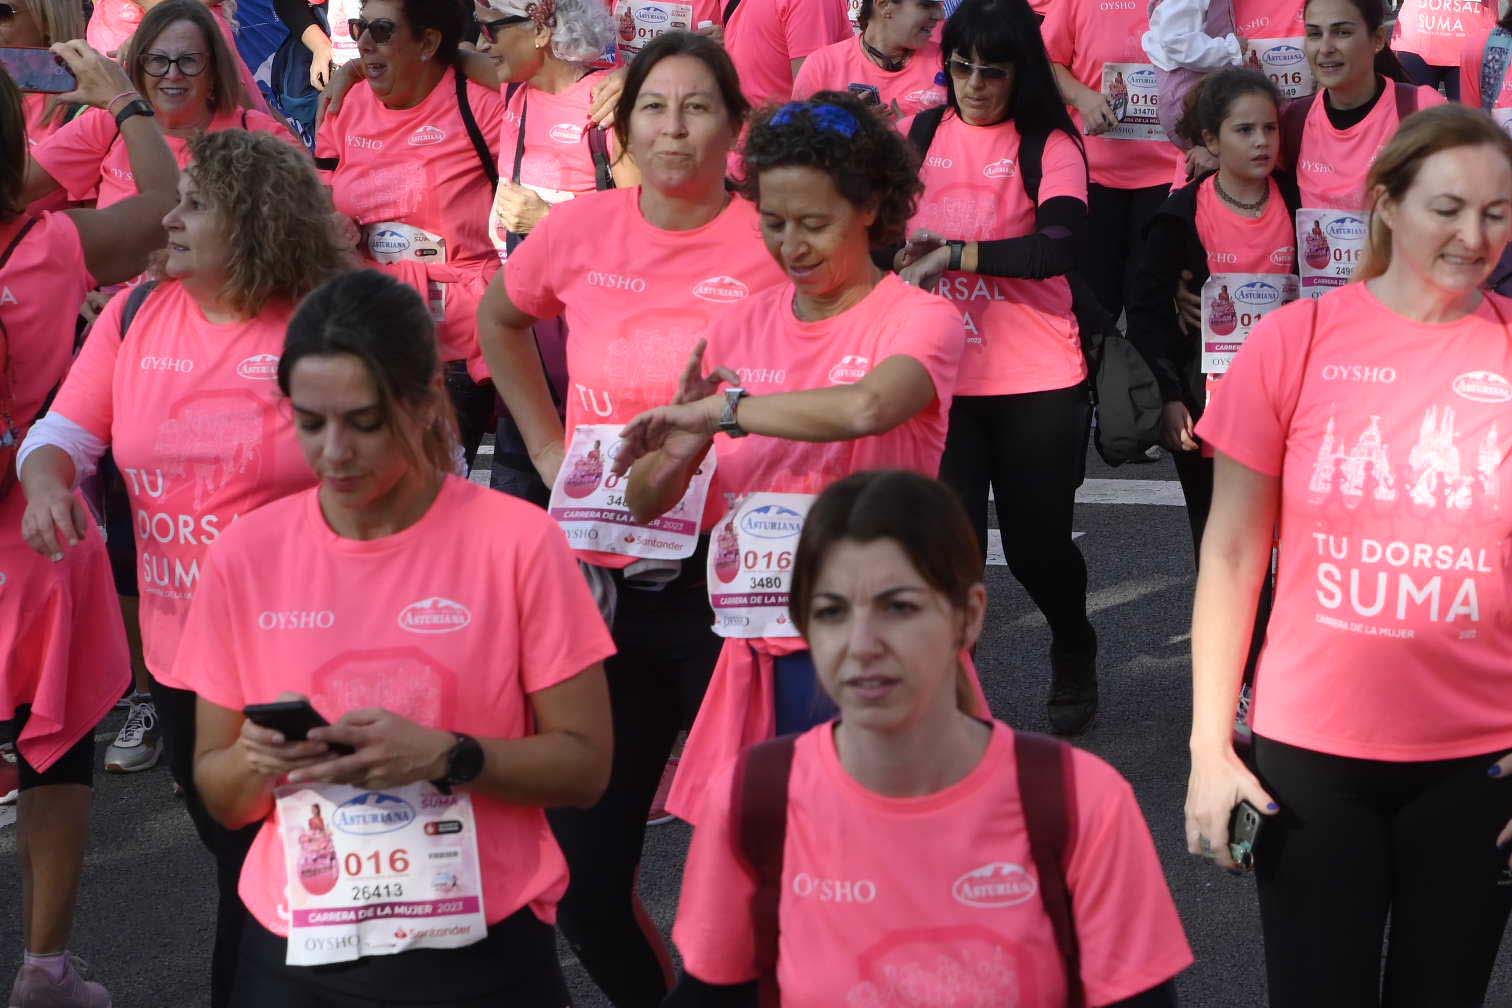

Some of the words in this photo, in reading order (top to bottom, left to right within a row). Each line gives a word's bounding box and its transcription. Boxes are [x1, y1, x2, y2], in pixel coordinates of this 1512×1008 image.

[1099, 0, 1136, 11] OYSHO
[1418, 14, 1464, 32] SUMA
[1130, 93, 1159, 105] 016
[1132, 107, 1156, 116] 31470
[587, 271, 646, 293] OYSHO
[141, 355, 195, 374] OYSHO
[1321, 364, 1398, 384] OYSHO
[575, 382, 614, 418] TU
[124, 467, 165, 498] TU
[563, 509, 601, 522] CARRERA
[601, 512, 615, 521] DE
[615, 512, 629, 522] LA
[635, 534, 684, 552] Santander
[1312, 531, 1348, 560] TU
[1361, 538, 1492, 573] DORSAL
[743, 550, 792, 570] 016
[749, 575, 782, 589] 3480
[750, 597, 764, 605] DE
[1315, 561, 1481, 623] SUMA
[258, 609, 335, 631] OYSHO
[400, 607, 470, 629] ASTURIANA
[1350, 621, 1365, 633] DE
[1366, 623, 1378, 635] LA
[1379, 626, 1415, 640] MUJER
[338, 808, 411, 827] ASTURIANA
[344, 847, 411, 877] 016
[352, 882, 404, 902] 26413
[308, 910, 356, 924] CARRERA
[357, 908, 376, 920] DE
[376, 906, 393, 917] LA
[393, 903, 434, 915] MUJER
[436, 902, 464, 914] 2023
[407, 924, 472, 941] Santander
[304, 934, 362, 953] OYSHO
